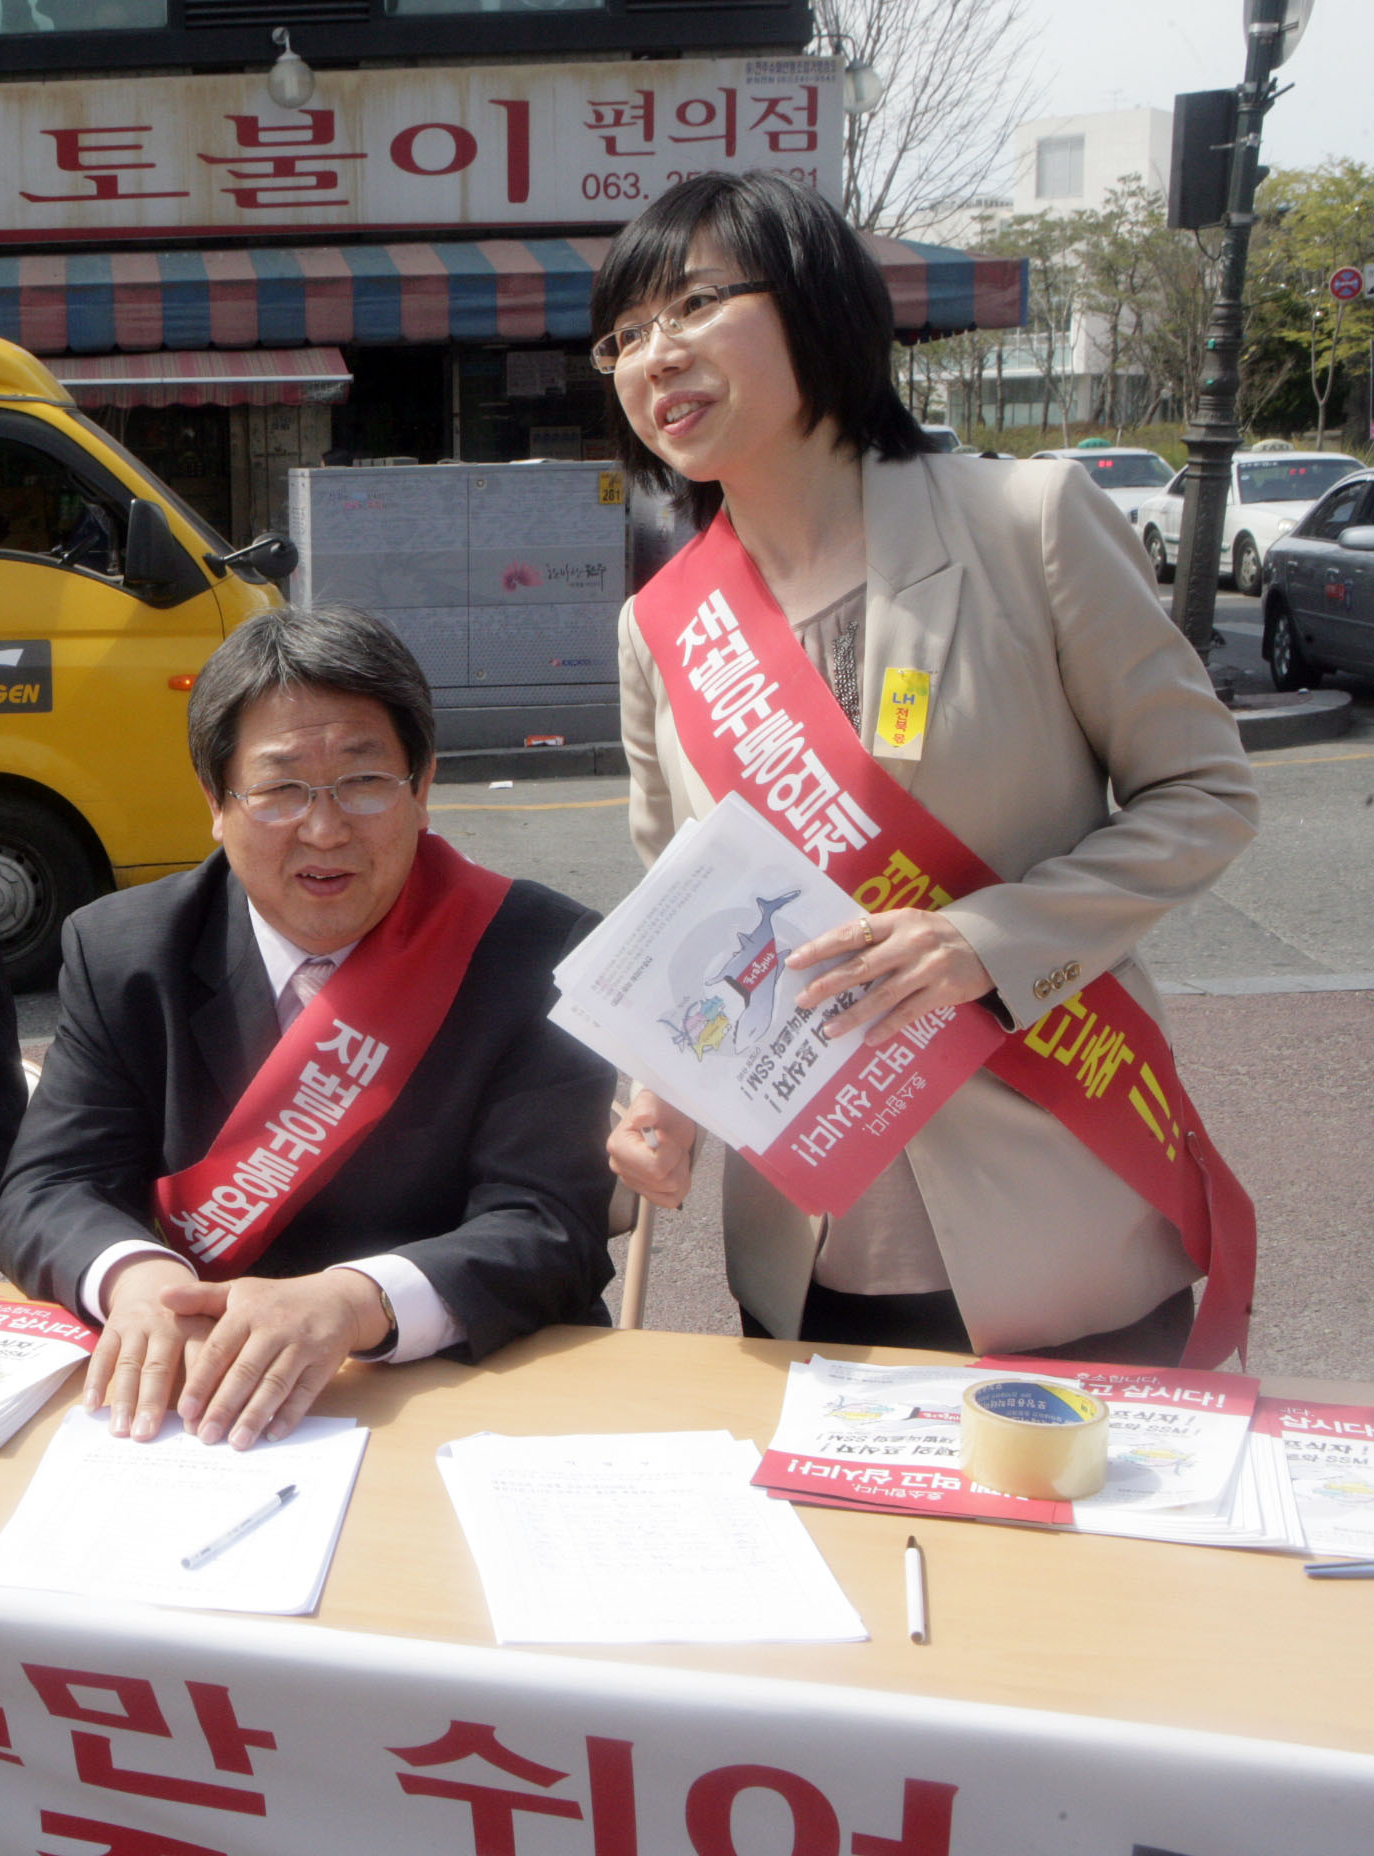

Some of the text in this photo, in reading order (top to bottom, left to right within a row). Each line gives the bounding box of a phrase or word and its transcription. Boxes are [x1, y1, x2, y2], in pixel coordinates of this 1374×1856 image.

[583, 85, 819, 158] 편의점
[892, 692, 915, 705] LH
[675, 588, 882, 872] 재벌유통업체
[745, 1052, 777, 1094] SSM
[857, 1042, 916, 1093] 먹고
[169, 1018, 390, 1263] 재벌유통업체
[790, 1082, 870, 1168] 삽시다!
[8, 1315, 91, 1340] 삽시다!
[1122, 1383, 1227, 1408] 삽시다!
[787, 1458, 893, 1484] 삽시다!
[900, 1470, 961, 1491] 먹고
